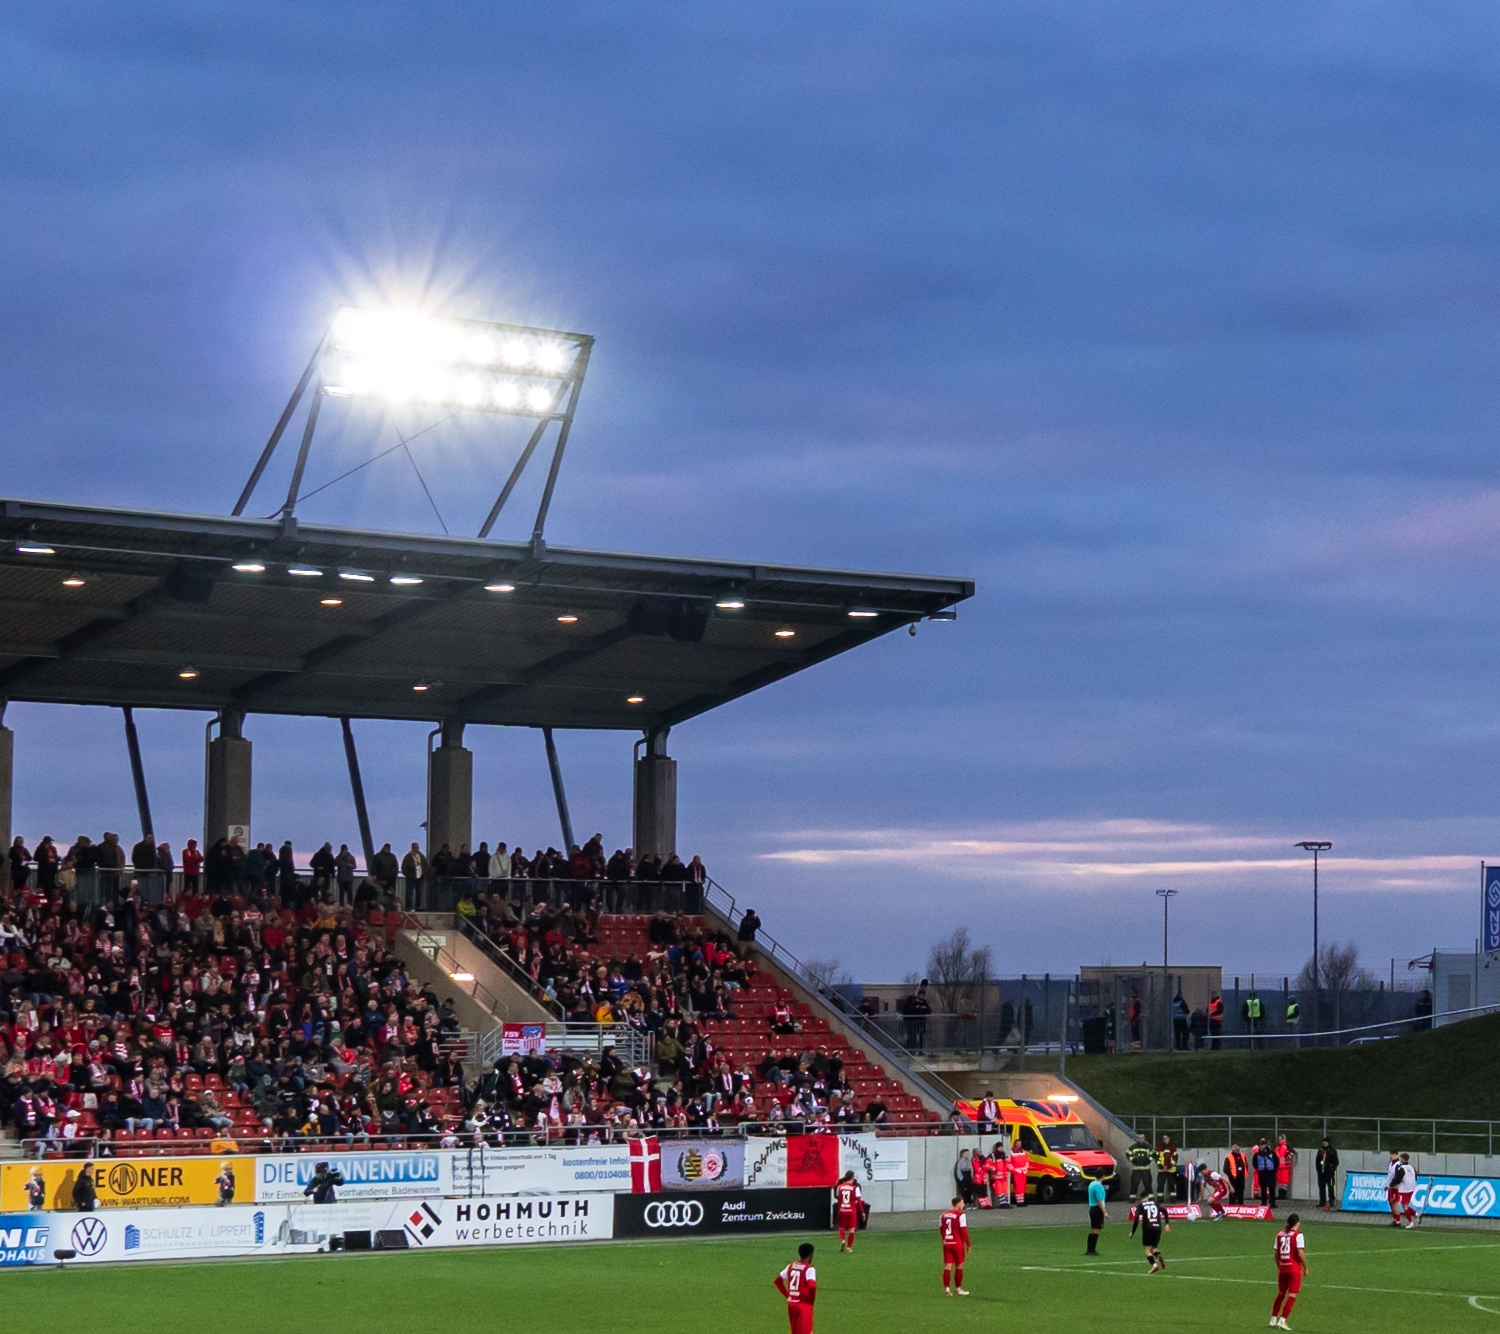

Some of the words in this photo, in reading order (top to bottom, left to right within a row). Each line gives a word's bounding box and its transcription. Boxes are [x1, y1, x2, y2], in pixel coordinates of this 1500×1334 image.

[562, 1156, 608, 1167] kostenfreie
[263, 1162, 294, 1184] DIE
[299, 1157, 437, 1185] WNNENTÜR
[390, 1184, 441, 1196] Badewanne
[456, 1199, 590, 1223] HOHMUTH
[721, 1200, 746, 1211] Audi
[721, 1211, 764, 1223] Zentrum
[765, 1210, 806, 1221] Zwickau
[210, 1223, 252, 1239] LIPPERT
[456, 1221, 589, 1241] werbetechnik
